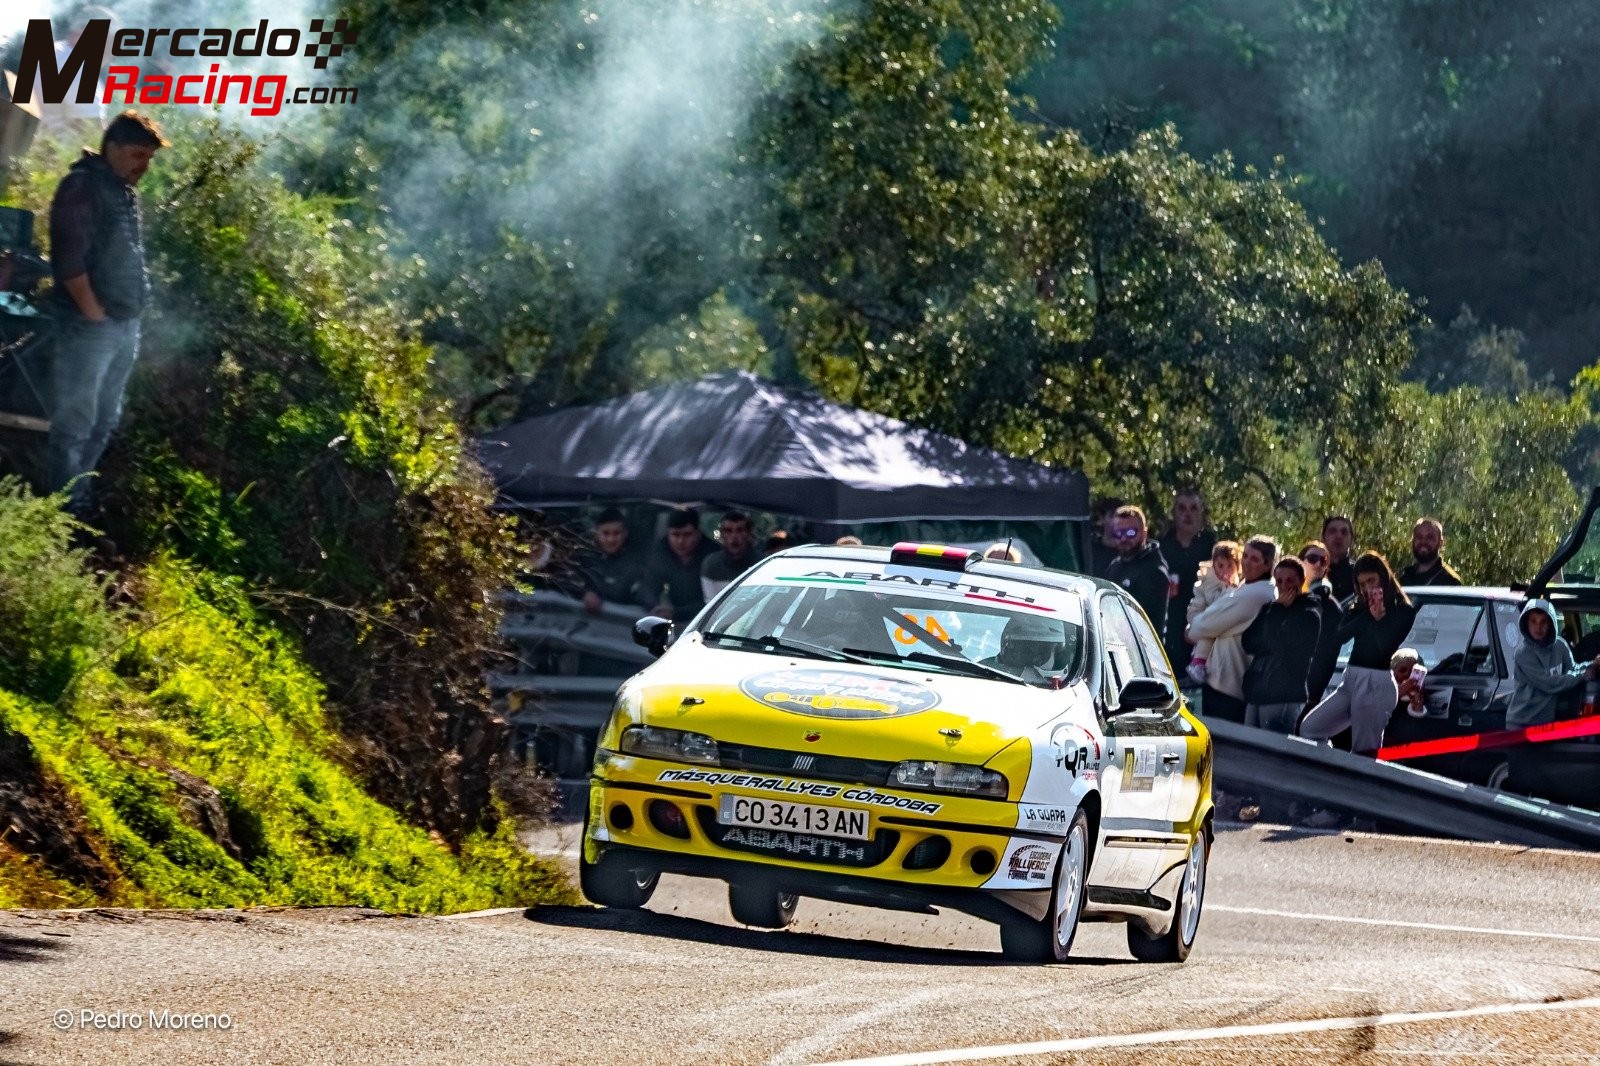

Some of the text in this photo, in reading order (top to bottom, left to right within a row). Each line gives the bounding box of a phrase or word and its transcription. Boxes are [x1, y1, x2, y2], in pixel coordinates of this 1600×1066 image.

[804, 571, 1035, 603] ABARTH
[657, 768, 941, 814] MÁSQUERALLYES CÓRDOBA
[735, 799, 765, 824] CO
[769, 803, 829, 831] 3413
[834, 810, 864, 836] AN
[1024, 808, 1066, 823] LA GUAPA
[722, 827, 864, 861] ABARTH
